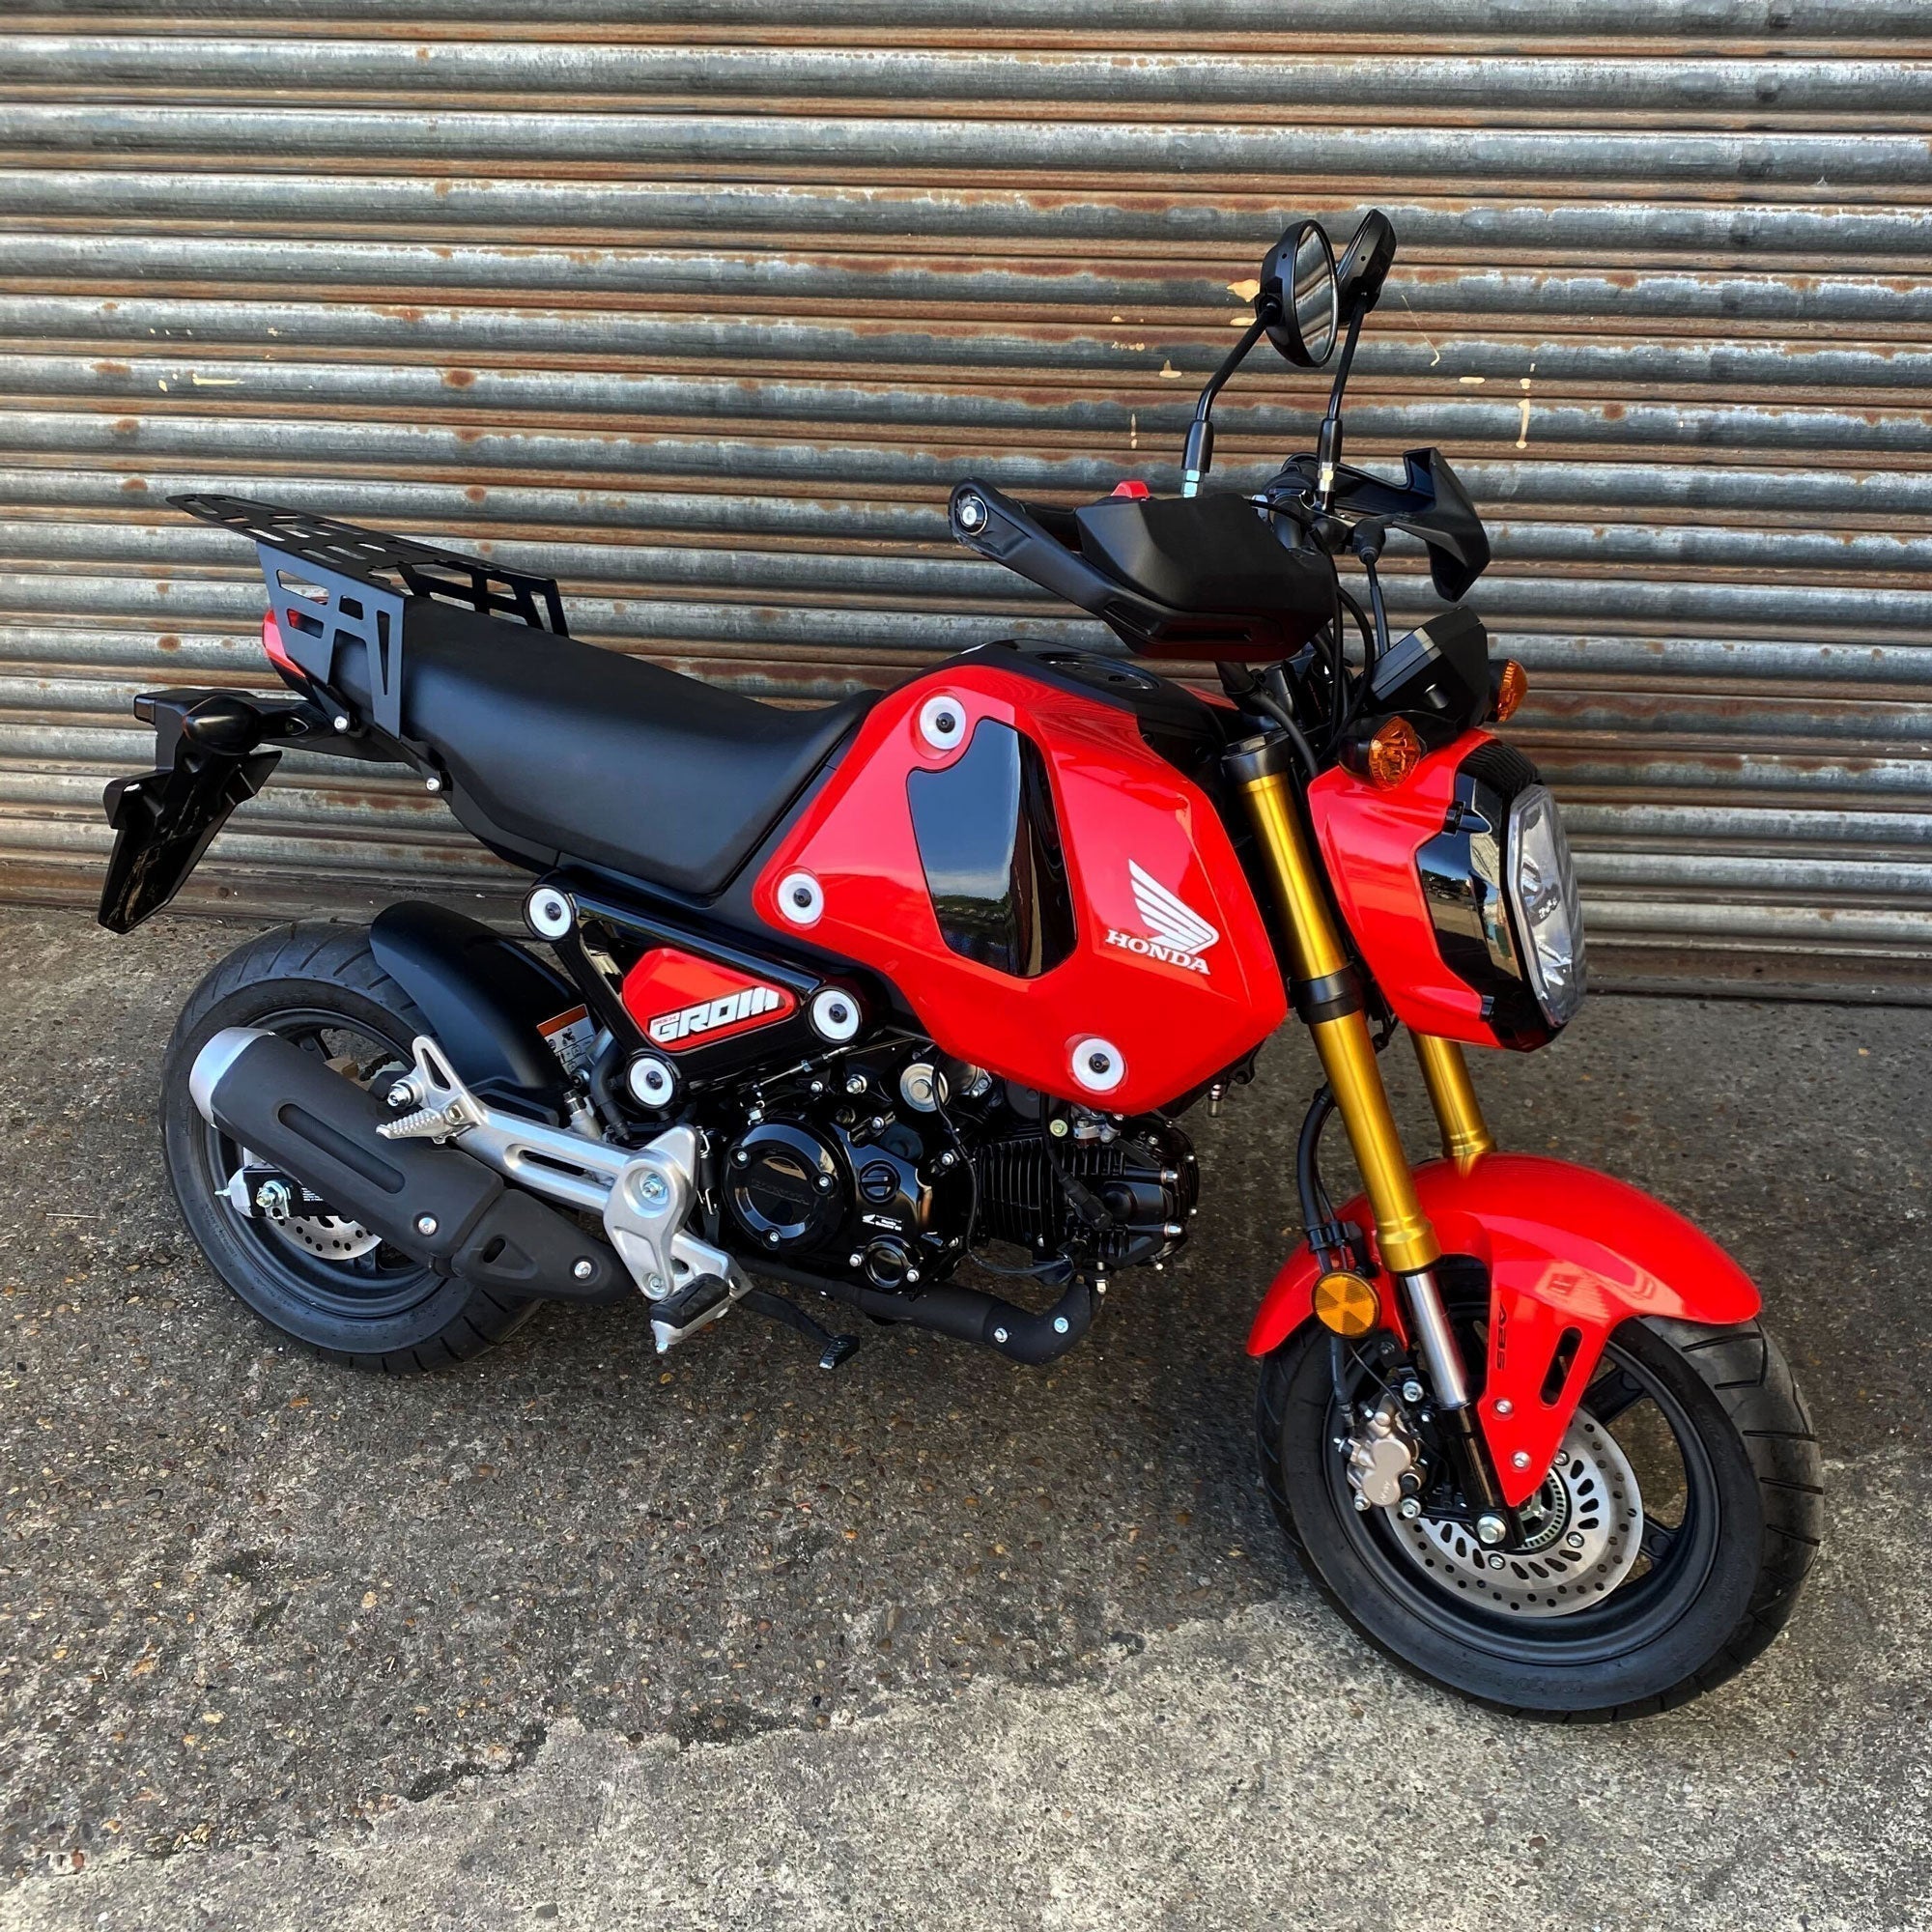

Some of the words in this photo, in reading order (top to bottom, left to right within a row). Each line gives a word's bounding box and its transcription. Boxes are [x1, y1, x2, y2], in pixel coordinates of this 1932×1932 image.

[1105, 929, 1210, 975] HONDA
[649, 986, 780, 1042] GROM
[1496, 1300, 1507, 1371] ABS
